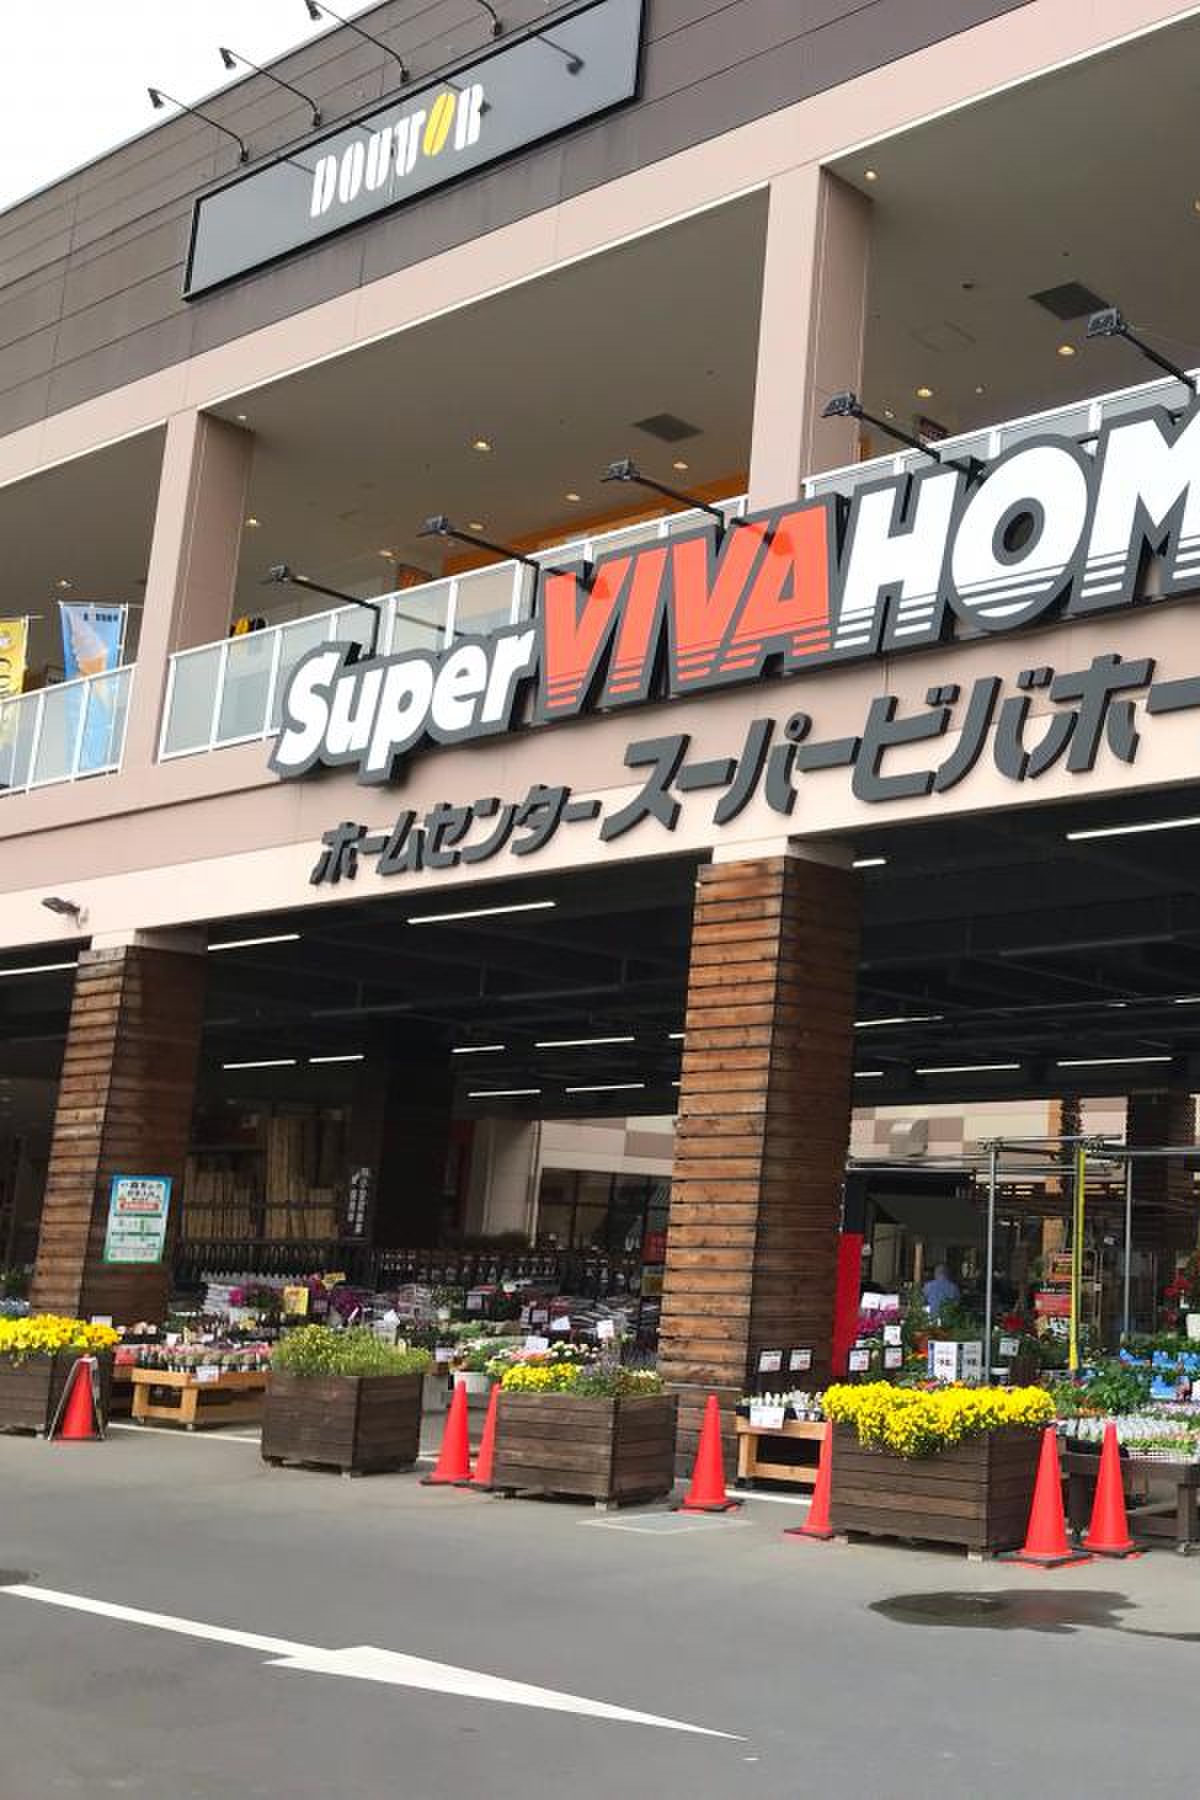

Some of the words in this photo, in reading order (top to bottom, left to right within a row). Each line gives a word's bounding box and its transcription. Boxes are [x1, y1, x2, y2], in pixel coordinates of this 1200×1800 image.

[310, 84, 483, 218] DOUTOR
[272, 627, 540, 776] Super
[309, 784, 602, 885] ホームセンター
